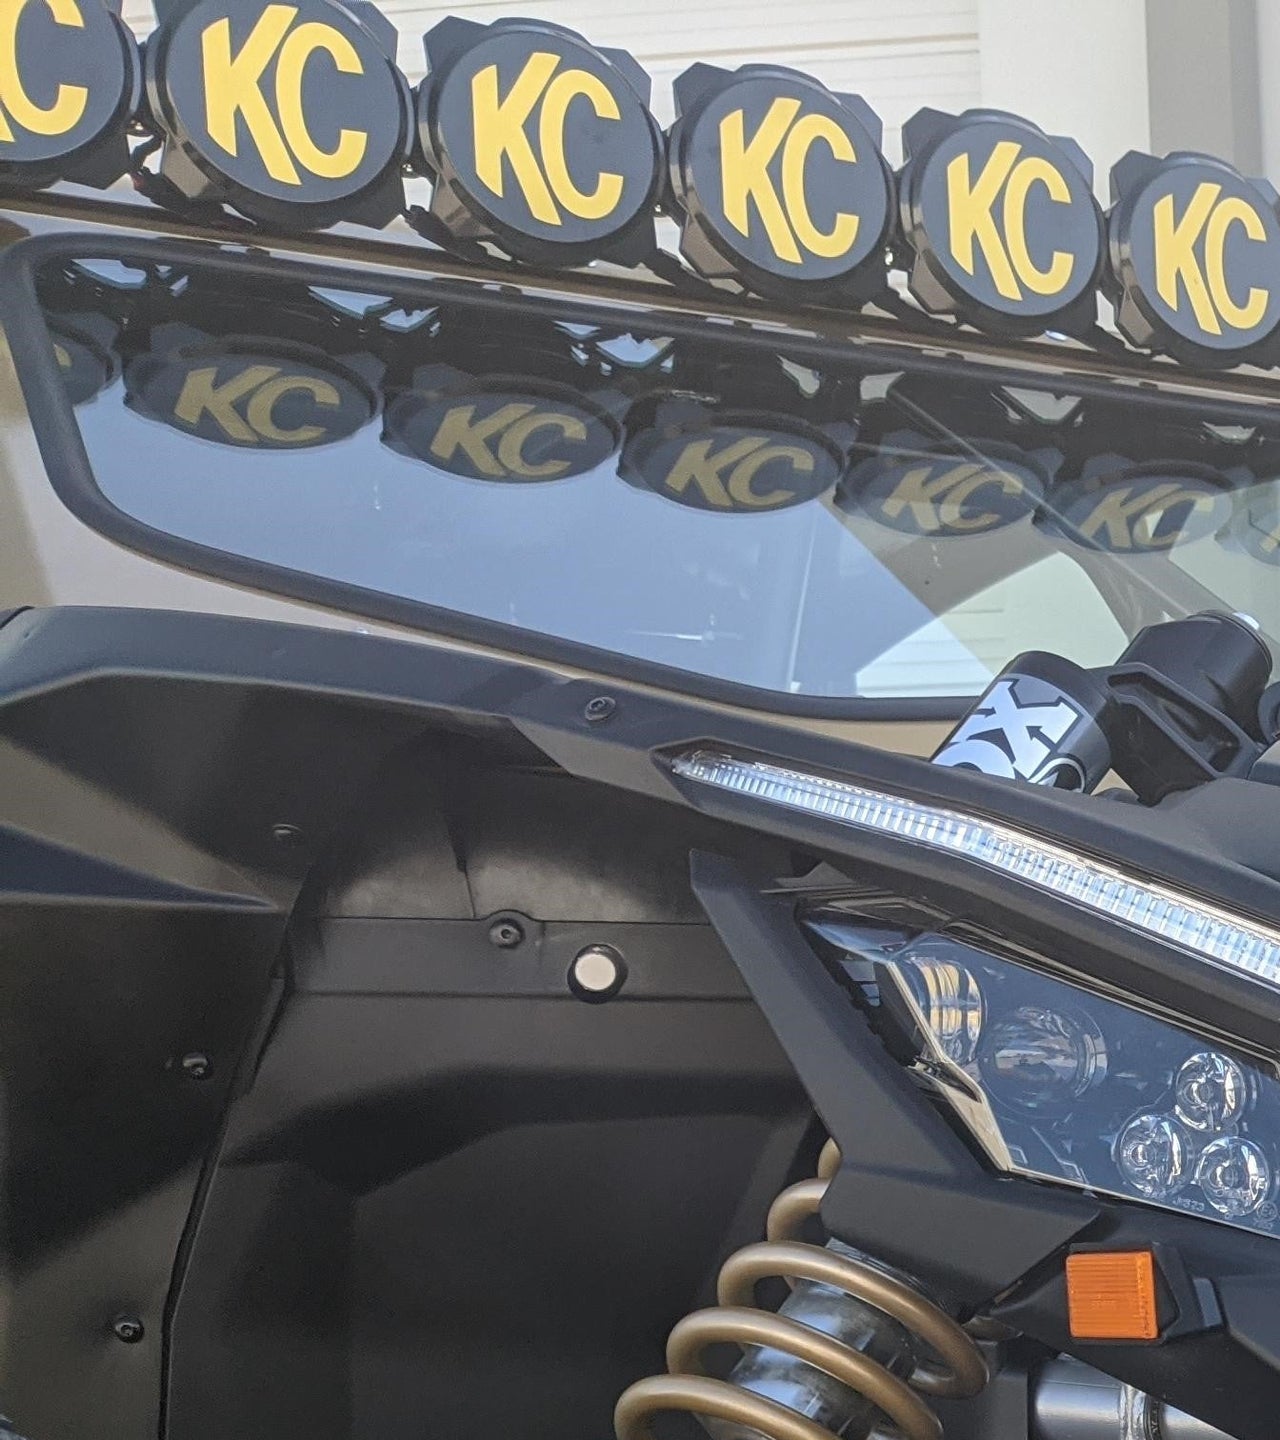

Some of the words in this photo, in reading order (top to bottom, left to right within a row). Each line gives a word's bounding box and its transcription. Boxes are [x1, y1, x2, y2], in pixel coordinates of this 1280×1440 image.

[0, 0, 88, 143] C
[201, 4, 367, 186] KC
[471, 52, 624, 226] KC
[719, 97, 860, 264] KC
[947, 141, 1075, 301] KC
[1154, 182, 1269, 336] KC
